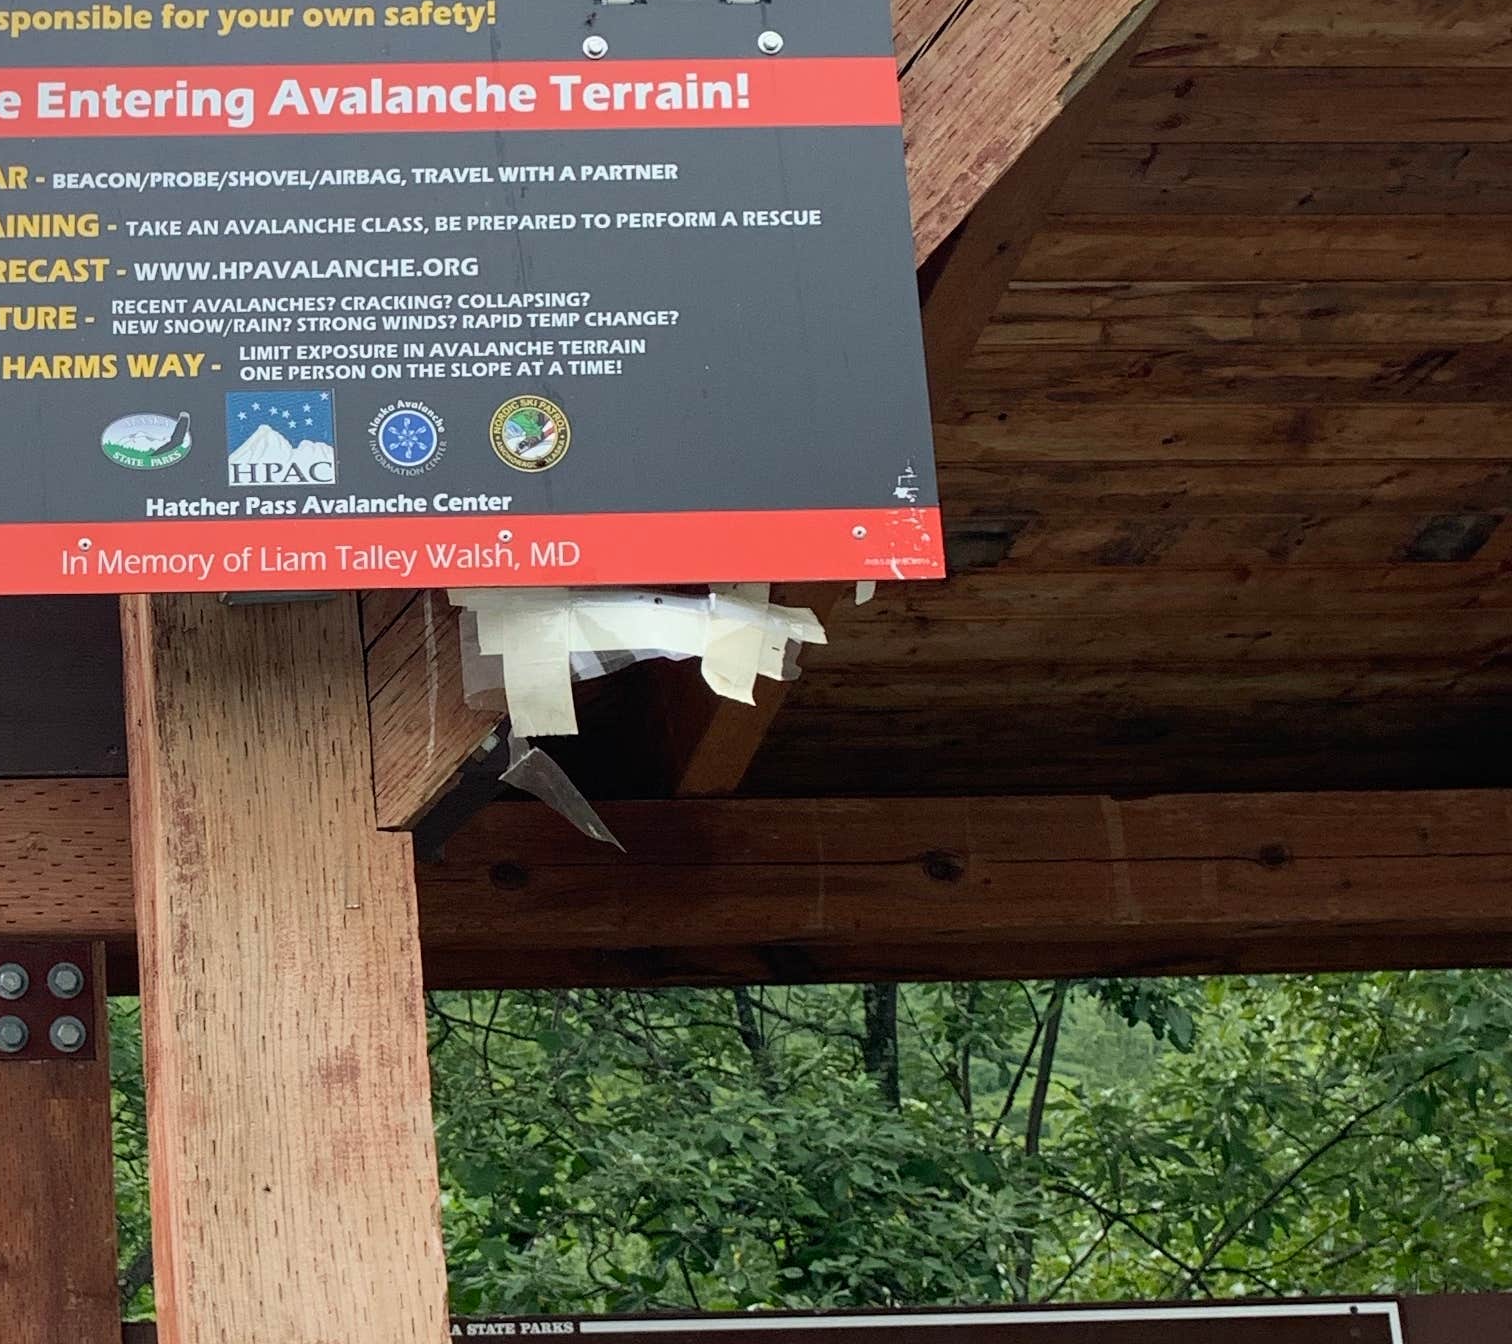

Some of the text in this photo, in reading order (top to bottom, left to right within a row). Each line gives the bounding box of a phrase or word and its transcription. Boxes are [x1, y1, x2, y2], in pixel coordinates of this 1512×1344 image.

[162, 4, 209, 28] for
[218, 8, 294, 35] your
[303, 6, 376, 27] own
[385, 0, 496, 32] safety!
[38, 80, 254, 128] Entering
[268, 77, 536, 115] Avalanche
[550, 73, 749, 111] Terrain!
[53, 169, 406, 192] BEACON/PROBE/SHOVEL/AIRBAG,
[412, 168, 494, 183] TRAVEL
[498, 166, 554, 182] WITH
[559, 166, 576, 181] A
[581, 164, 678, 180] PARTNER
[126, 221, 181, 236] TAKE
[187, 220, 218, 235] AN
[224, 218, 355, 234] AVALANCHE
[362, 217, 429, 234] CLASS,
[436, 216, 461, 231] BE
[468, 215, 576, 230] PREPARED
[581, 214, 610, 228] TO
[617, 212, 716, 228] PERFORM
[721, 212, 737, 226] A
[743, 210, 821, 226] RESCUE
[134, 258, 478, 280] WWW.HPAVALANCHE.ORG
[112, 292, 590, 314] RECENT AVALANCHES? CRACKING? COLLAPSING?
[240, 340, 645, 360] LIMIT EXPOSURE IN AVALANCHE TERRAIN
[3, 354, 118, 379] HARMS
[127, 353, 205, 377] WAY
[368, 399, 446, 436] Alaska Avalanche
[113, 451, 182, 468] STATE PARKS
[231, 461, 333, 485] HPAC
[147, 494, 512, 516] Hatcher Pass Avalanche Center
[63, 542, 580, 580] In Memory of Liam Talley Walsh, MD
[467, 1323, 515, 1335] STATE
[520, 1322, 574, 1334] PARKS
